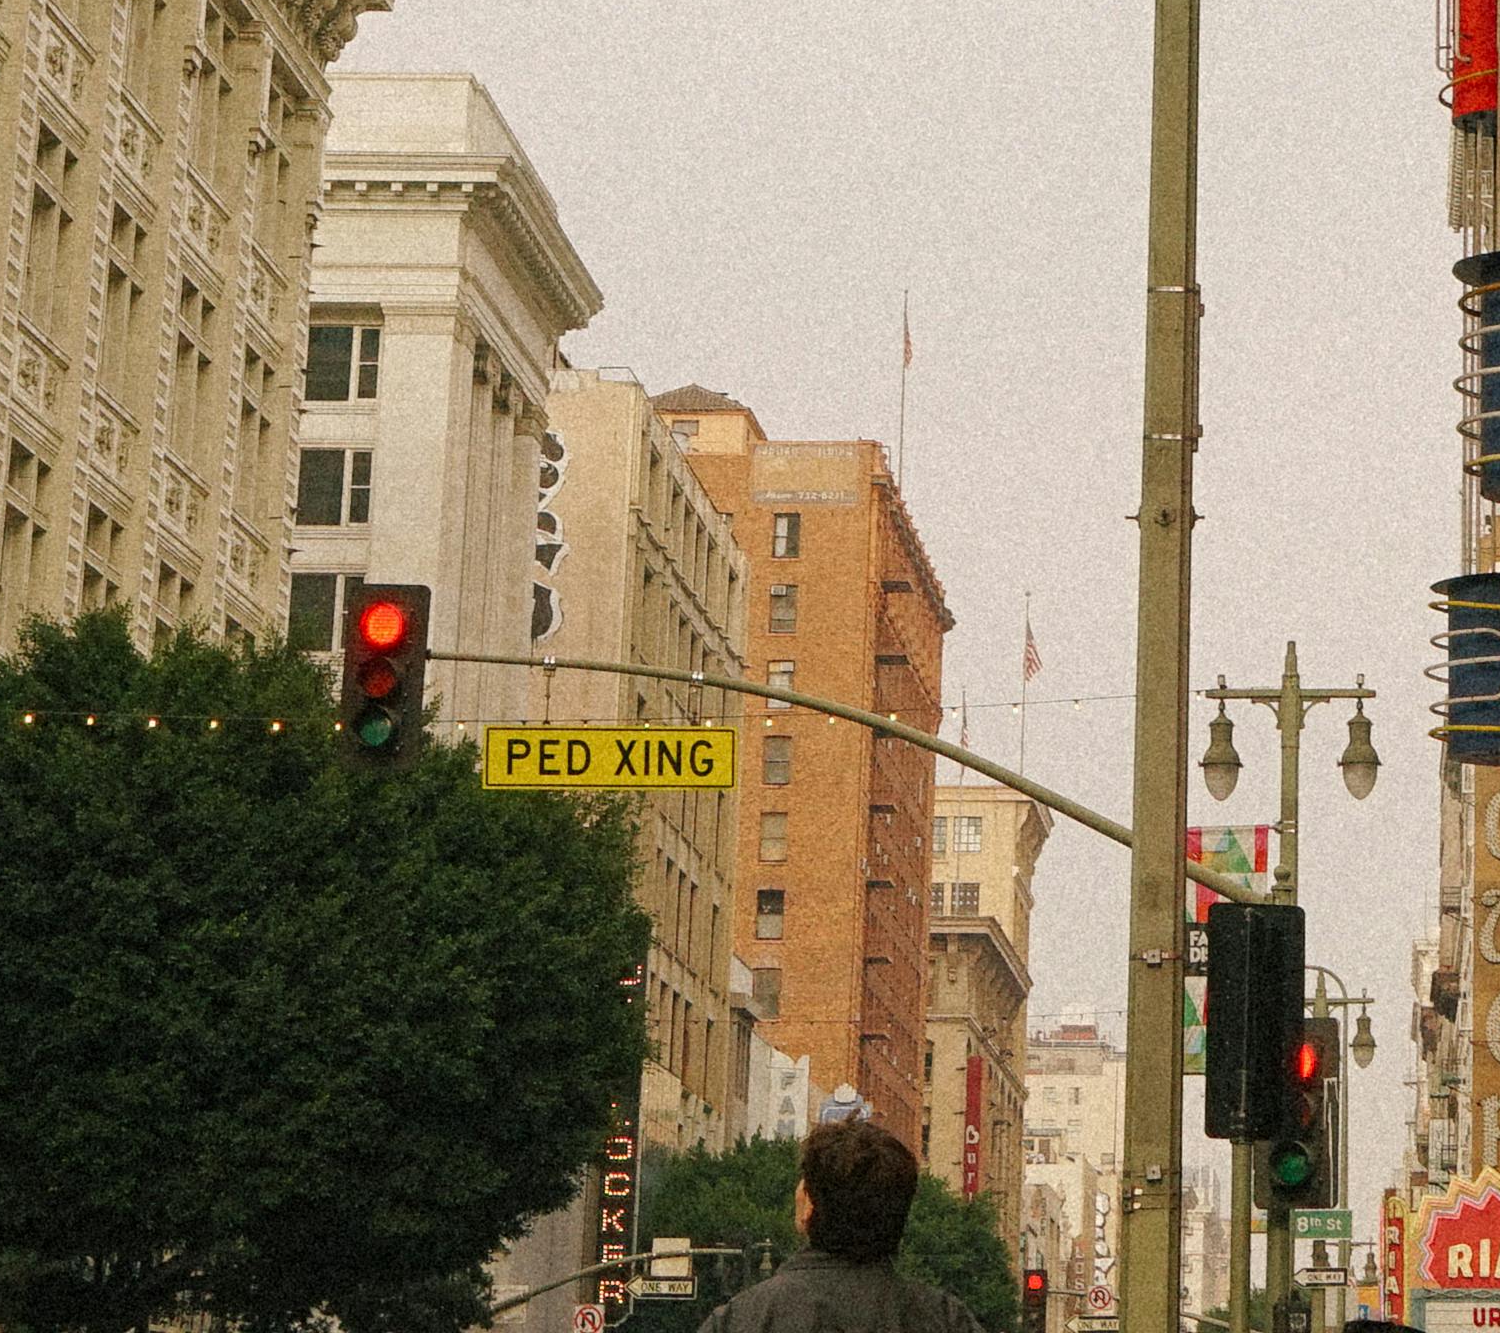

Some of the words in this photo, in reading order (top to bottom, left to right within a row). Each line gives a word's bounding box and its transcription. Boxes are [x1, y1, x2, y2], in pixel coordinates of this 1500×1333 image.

[506, 738, 592, 776] PED
[613, 739, 714, 777] XING
[1326, 1217, 1342, 1231] St
[640, 1282, 661, 1293] ONE
[668, 1282, 689, 1293] WAY
